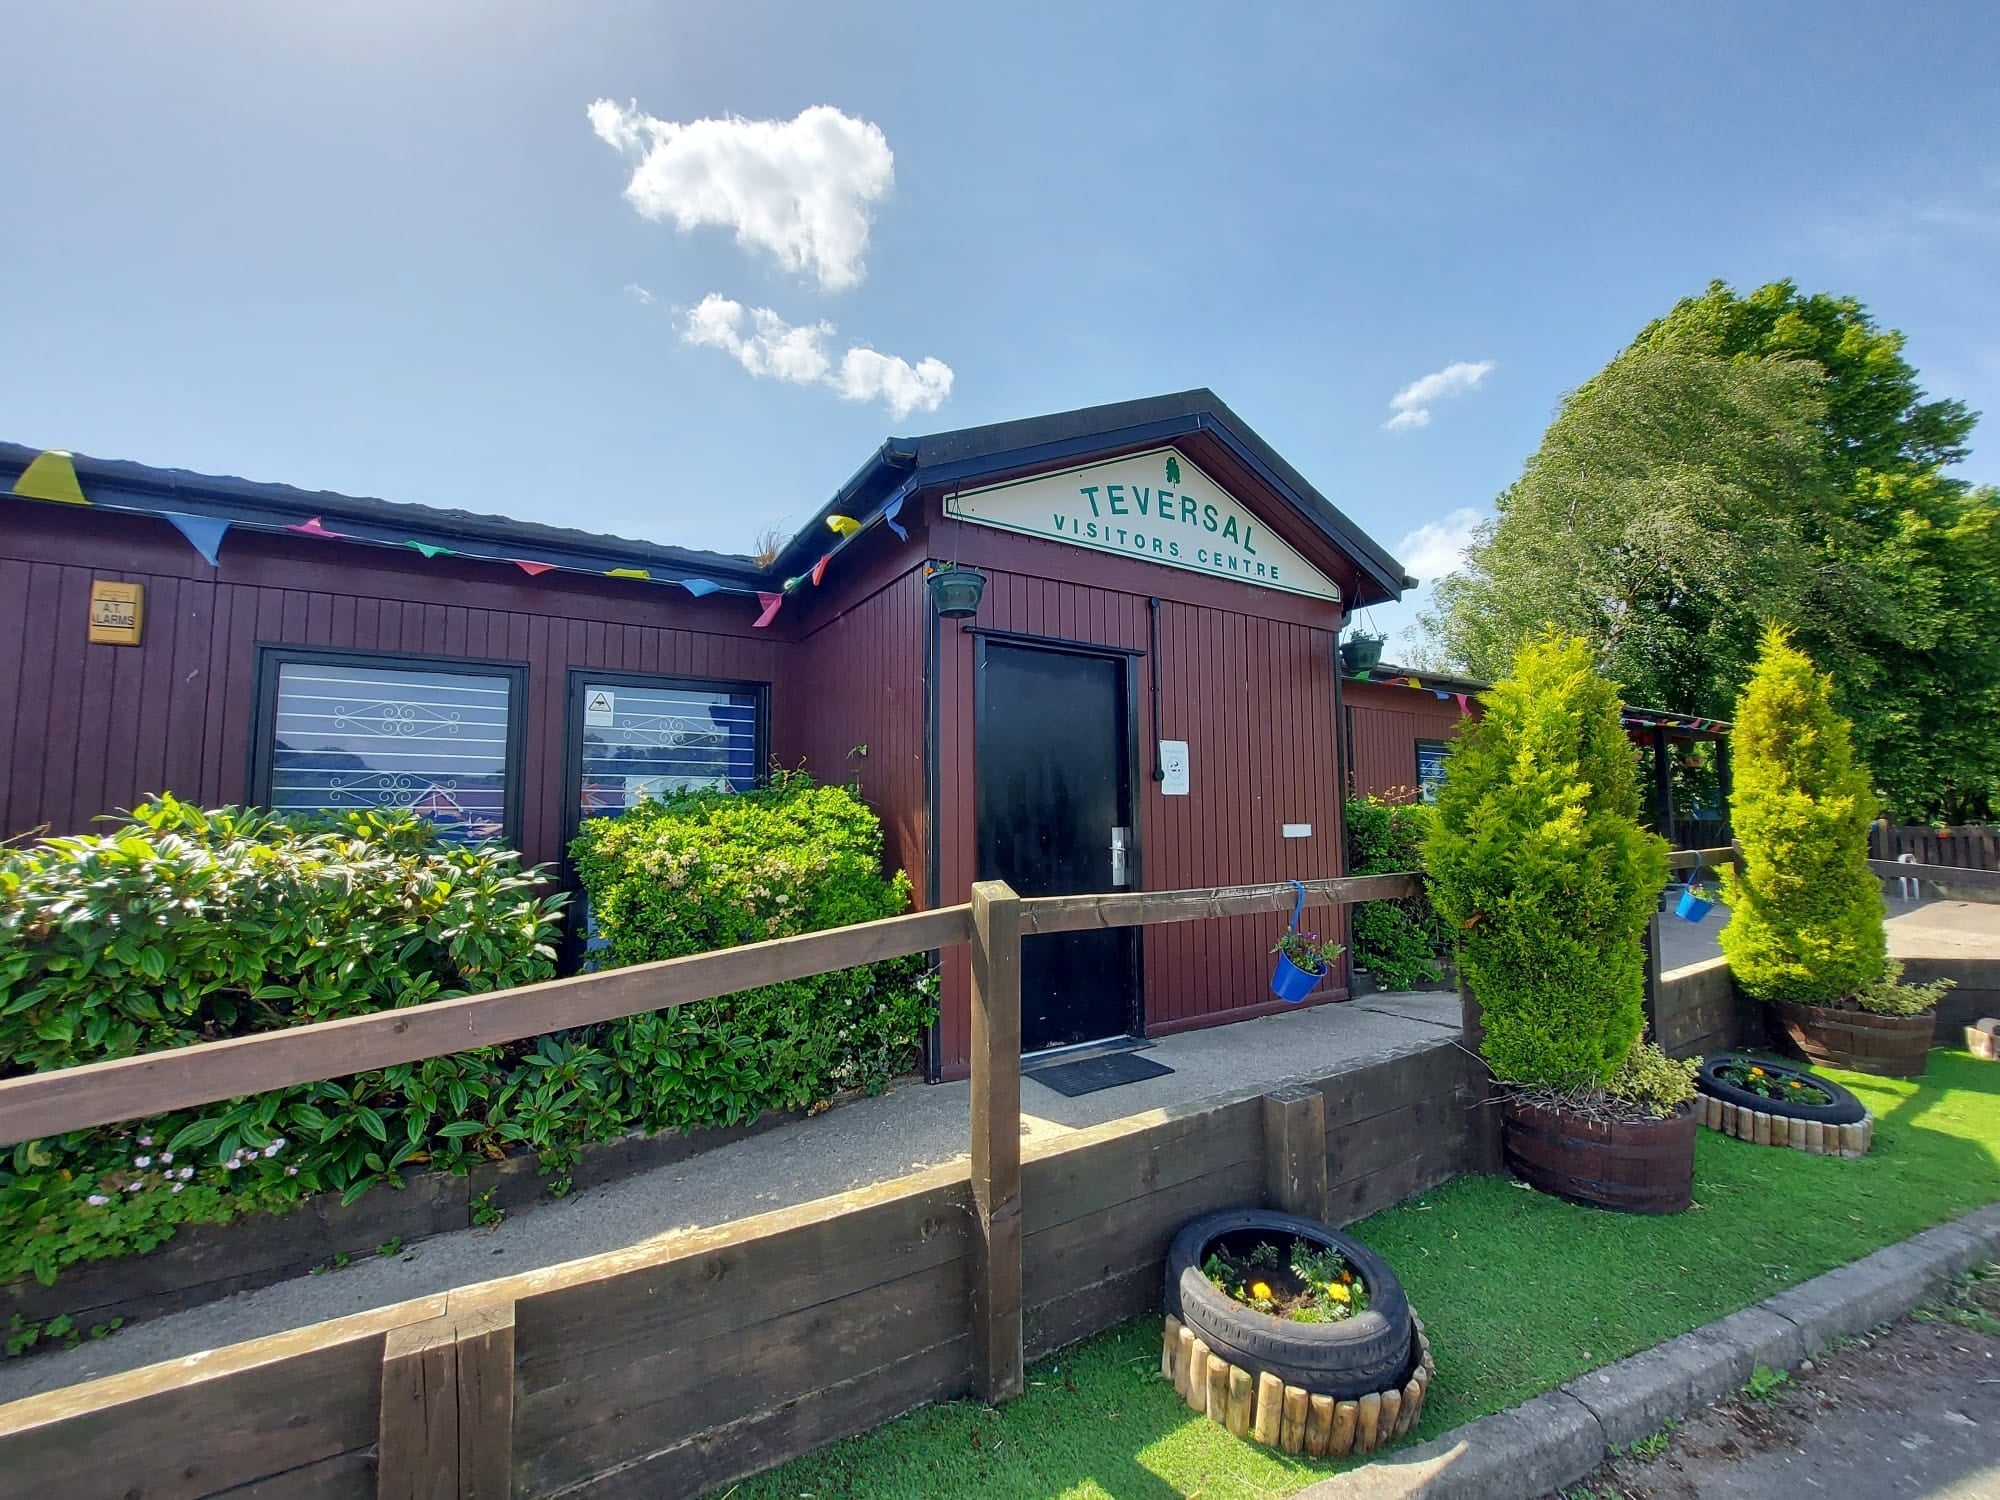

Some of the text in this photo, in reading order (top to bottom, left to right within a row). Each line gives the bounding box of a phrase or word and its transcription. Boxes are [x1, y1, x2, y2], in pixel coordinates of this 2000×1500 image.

[1053, 514, 1279, 580] VISITORS CENTRE
[1080, 485, 1258, 555] TEVERSAL
